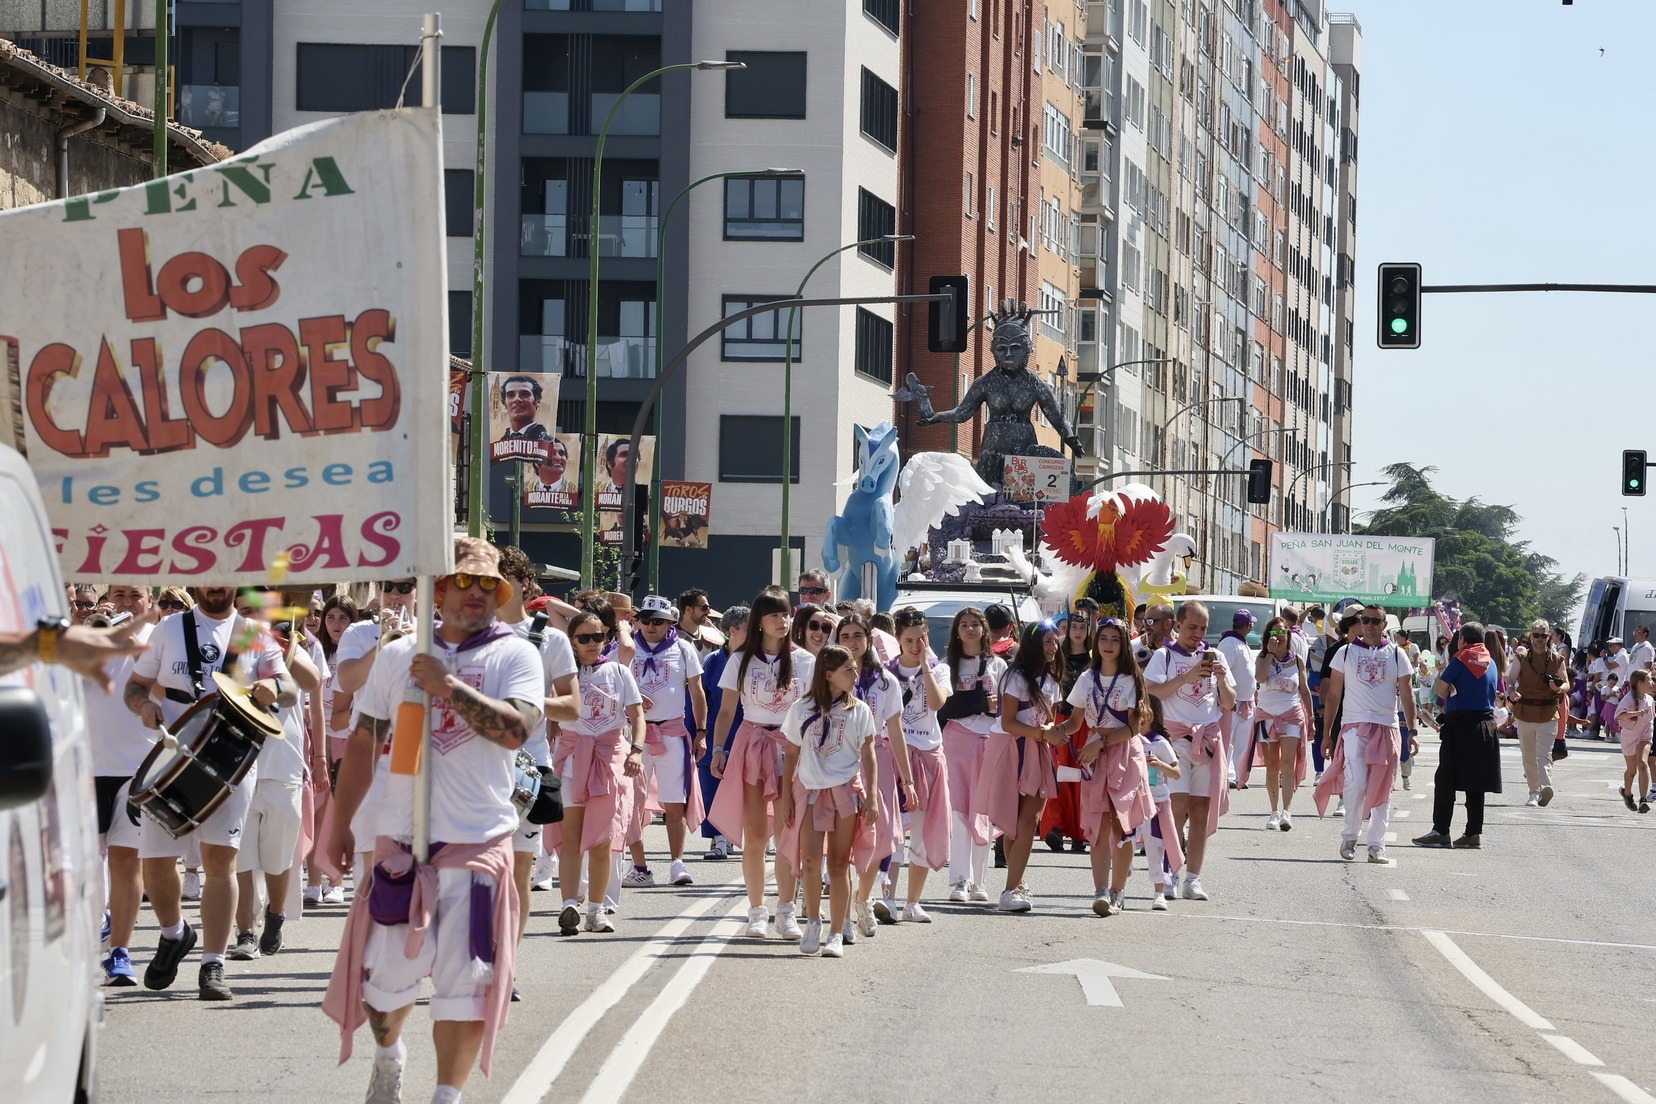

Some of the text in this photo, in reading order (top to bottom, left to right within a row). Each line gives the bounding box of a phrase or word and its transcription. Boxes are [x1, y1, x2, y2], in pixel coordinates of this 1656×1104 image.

[25, 307, 401, 459] CALORES
[494, 440, 533, 456] MORENITO
[61, 459, 396, 506] les desea
[528, 492, 559, 504] MORANTE
[598, 493, 622, 506] MORAN
[664, 496, 708, 516] BURGOS
[604, 530, 624, 541] MOREN
[1280, 539, 1424, 556] PEÑA SAN JUAN DEL MONTE
